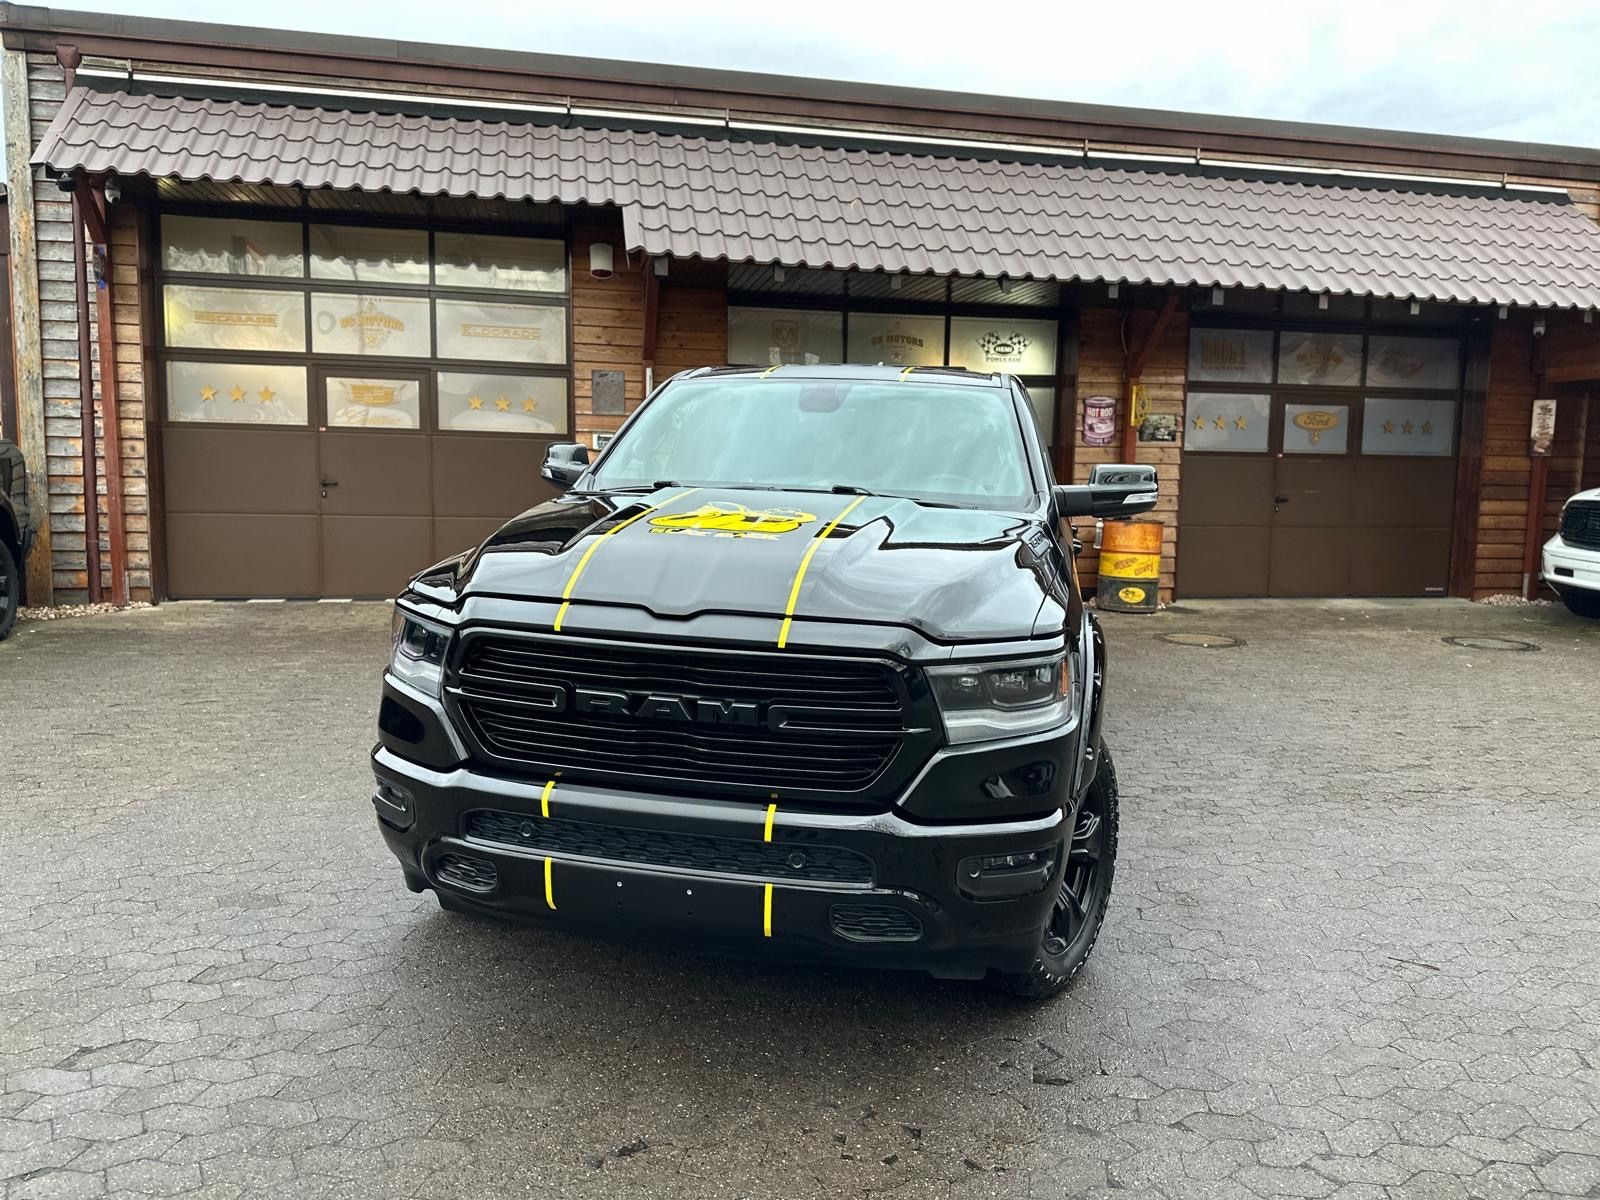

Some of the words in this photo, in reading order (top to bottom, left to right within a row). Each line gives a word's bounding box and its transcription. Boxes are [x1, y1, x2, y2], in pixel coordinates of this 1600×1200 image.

[463, 325, 541, 340] ELDORADO
[886, 334, 924, 347] MOTORS
[1087, 407, 1099, 418] HOT
[1100, 406, 1114, 418] ROD
[1303, 415, 1330, 426] Ford
[574, 688, 758, 727] RAM
